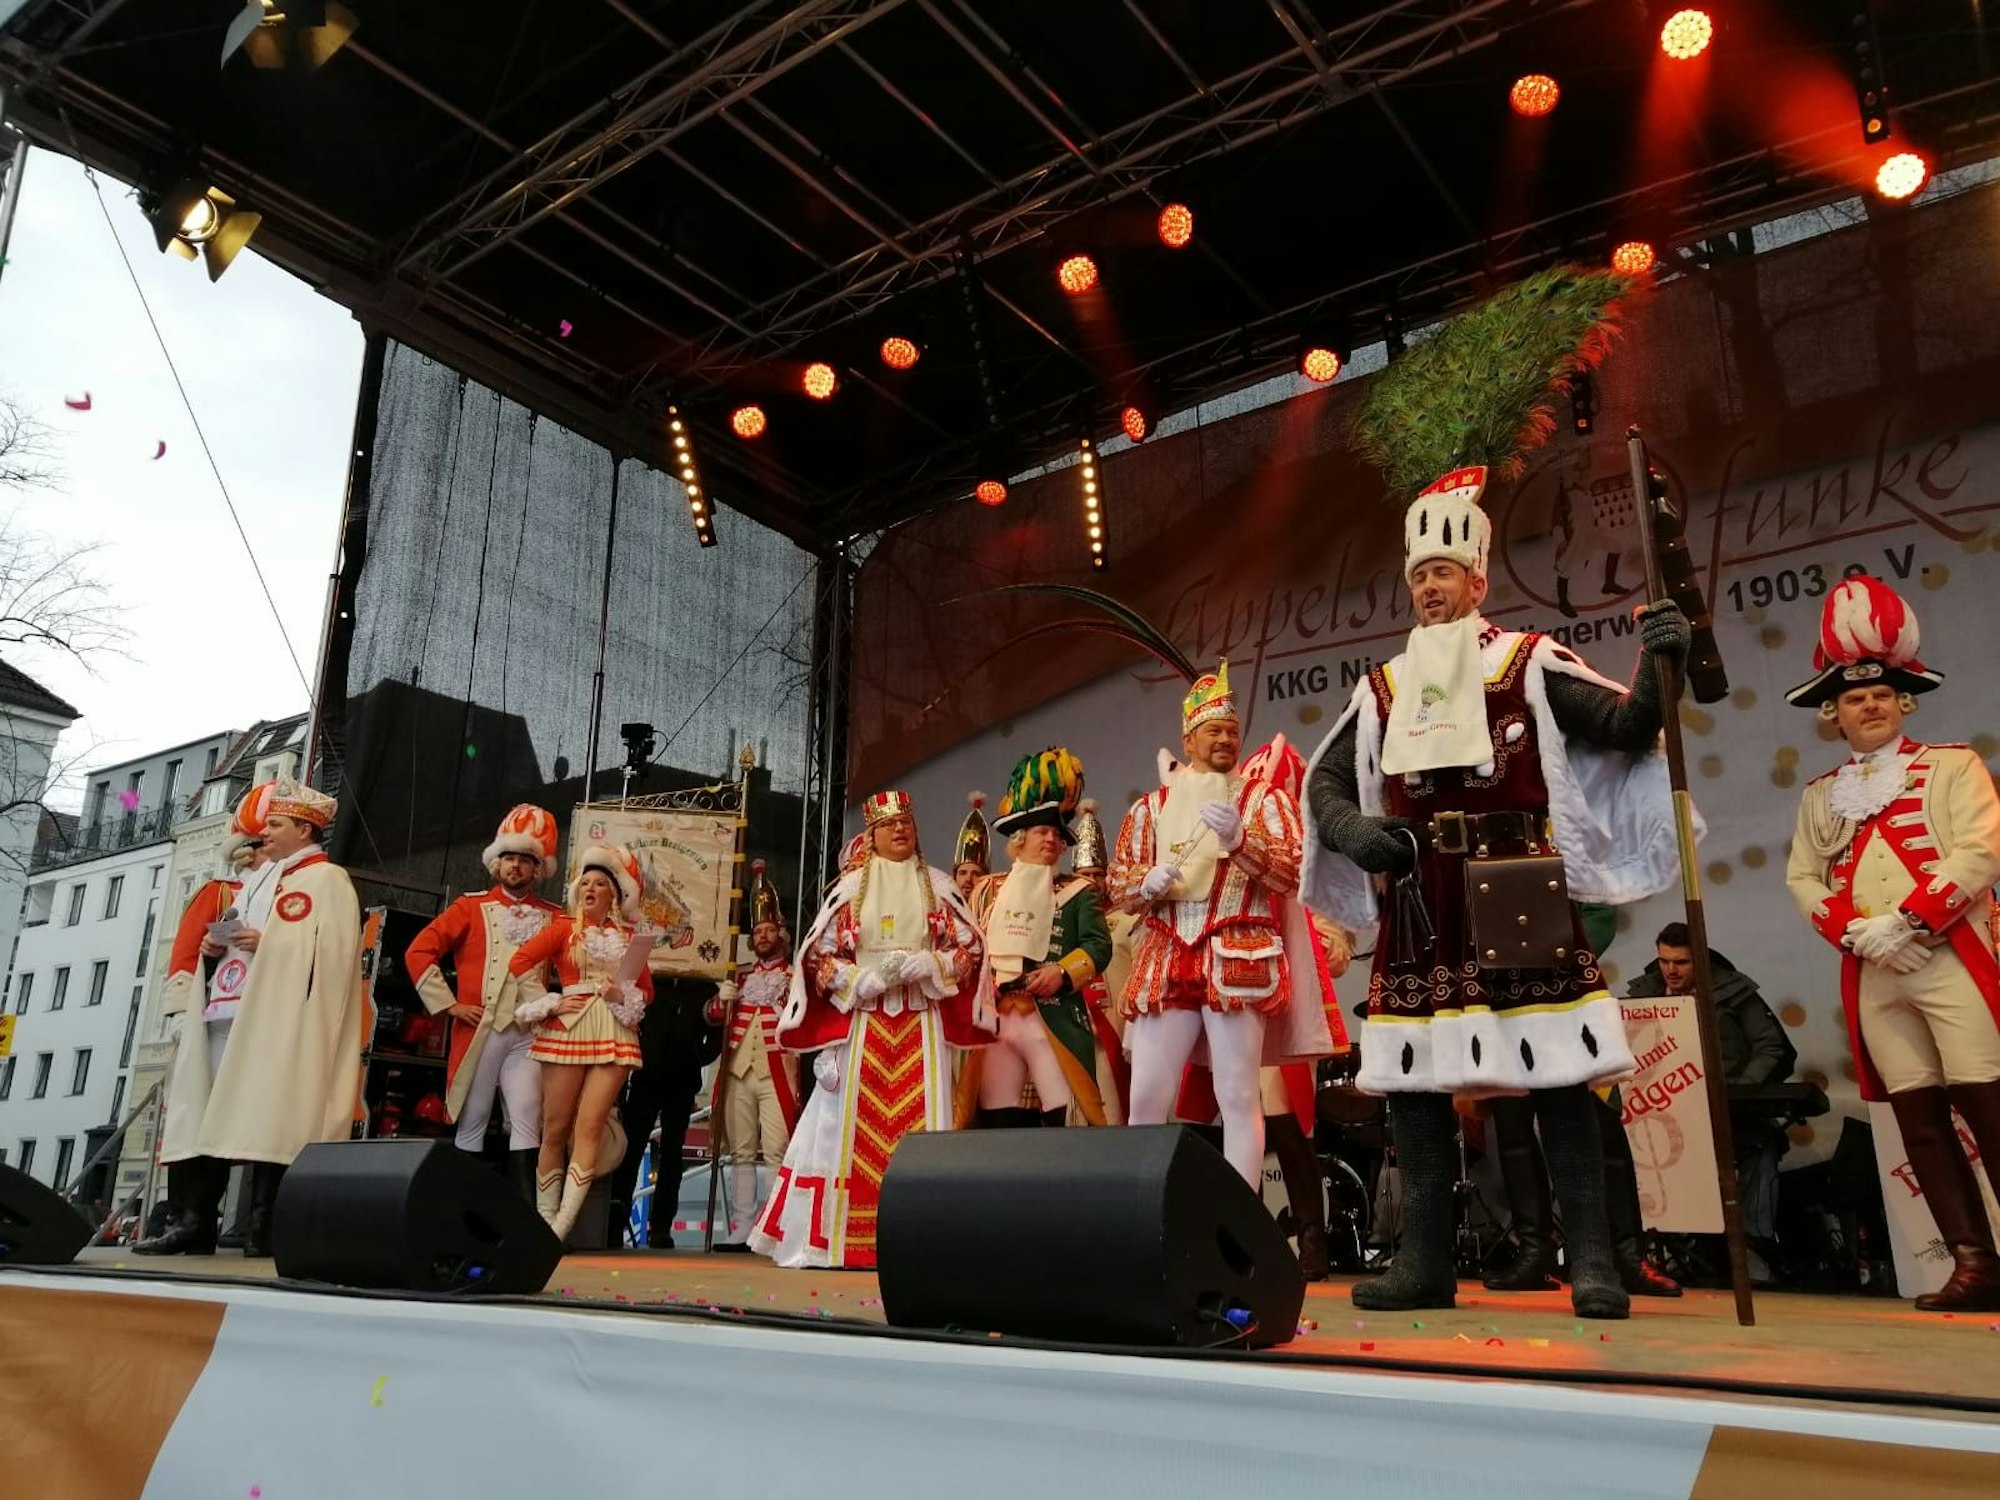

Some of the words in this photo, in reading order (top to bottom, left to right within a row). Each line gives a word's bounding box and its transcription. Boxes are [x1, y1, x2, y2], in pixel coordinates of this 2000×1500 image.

[1267, 664, 1328, 702] KKG
[1727, 563, 1828, 612] 1903
[1620, 1004, 1679, 1021] hester
[1634, 1034, 1679, 1074] lmut
